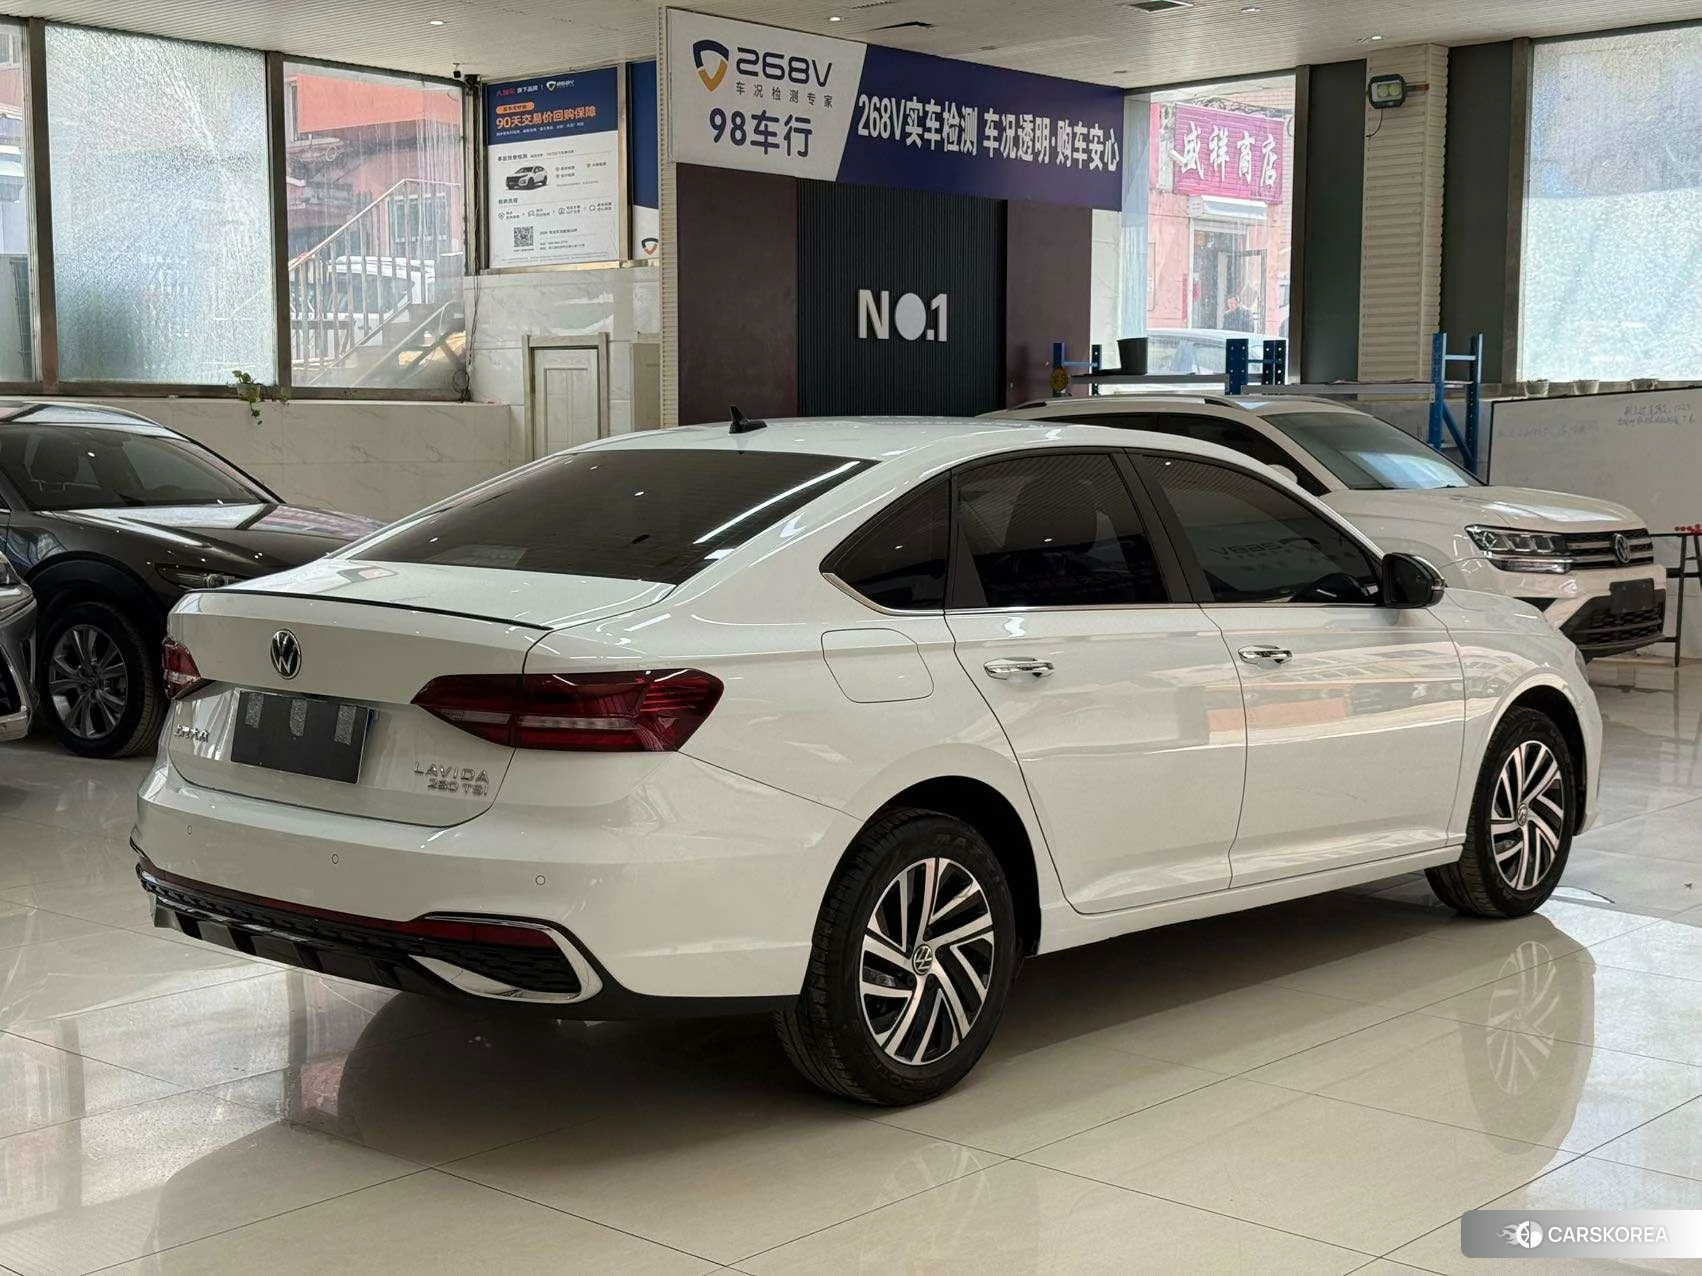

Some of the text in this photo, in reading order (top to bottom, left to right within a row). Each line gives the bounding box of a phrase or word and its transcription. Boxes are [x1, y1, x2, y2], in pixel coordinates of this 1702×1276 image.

[735, 46, 833, 88] 268V
[735, 80, 833, 111] 车况检测专家
[496, 105, 597, 129] 90天交易价回购保障
[709, 107, 813, 158] 98车行
[857, 94, 978, 157] 268V实车检测
[857, 289, 949, 343] NO.1
[413, 760, 490, 785] LAVIDA
